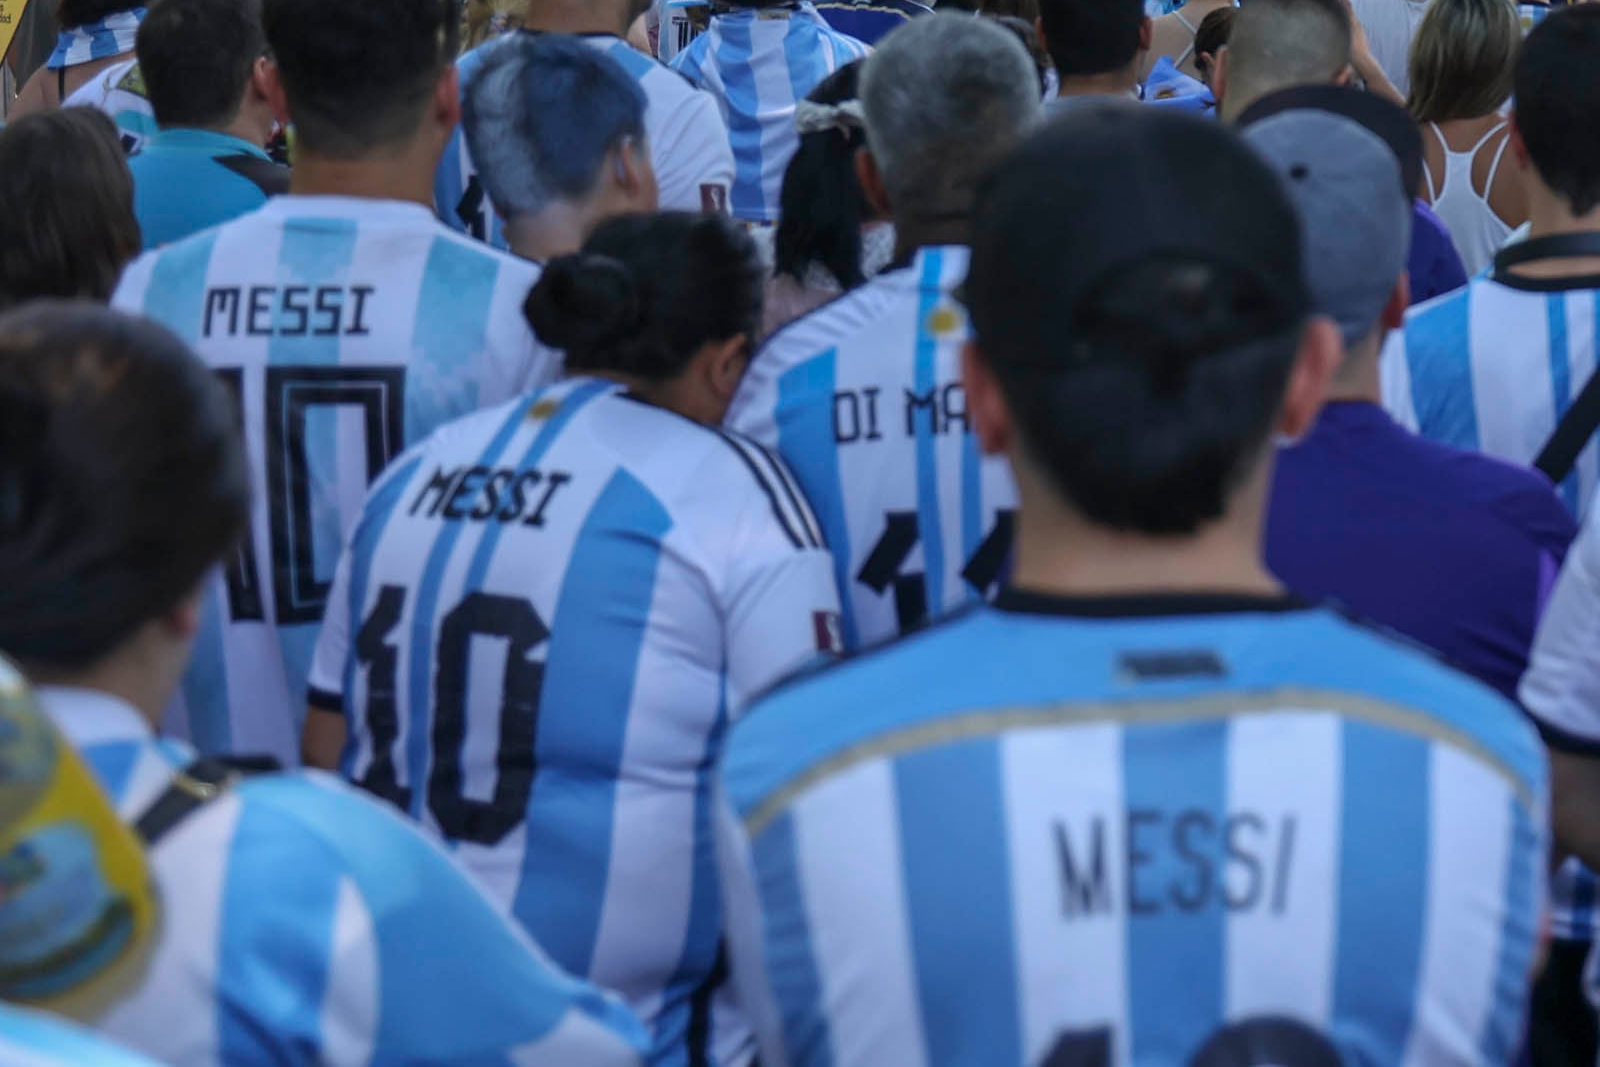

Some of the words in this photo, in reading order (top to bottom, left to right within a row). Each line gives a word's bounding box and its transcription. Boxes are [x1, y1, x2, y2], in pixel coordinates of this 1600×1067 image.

[203, 286, 374, 337] MESSI
[832, 387, 883, 444] DI
[408, 465, 571, 528] MESSI
[350, 583, 550, 848] 10
[1052, 809, 1296, 922] MESSI
